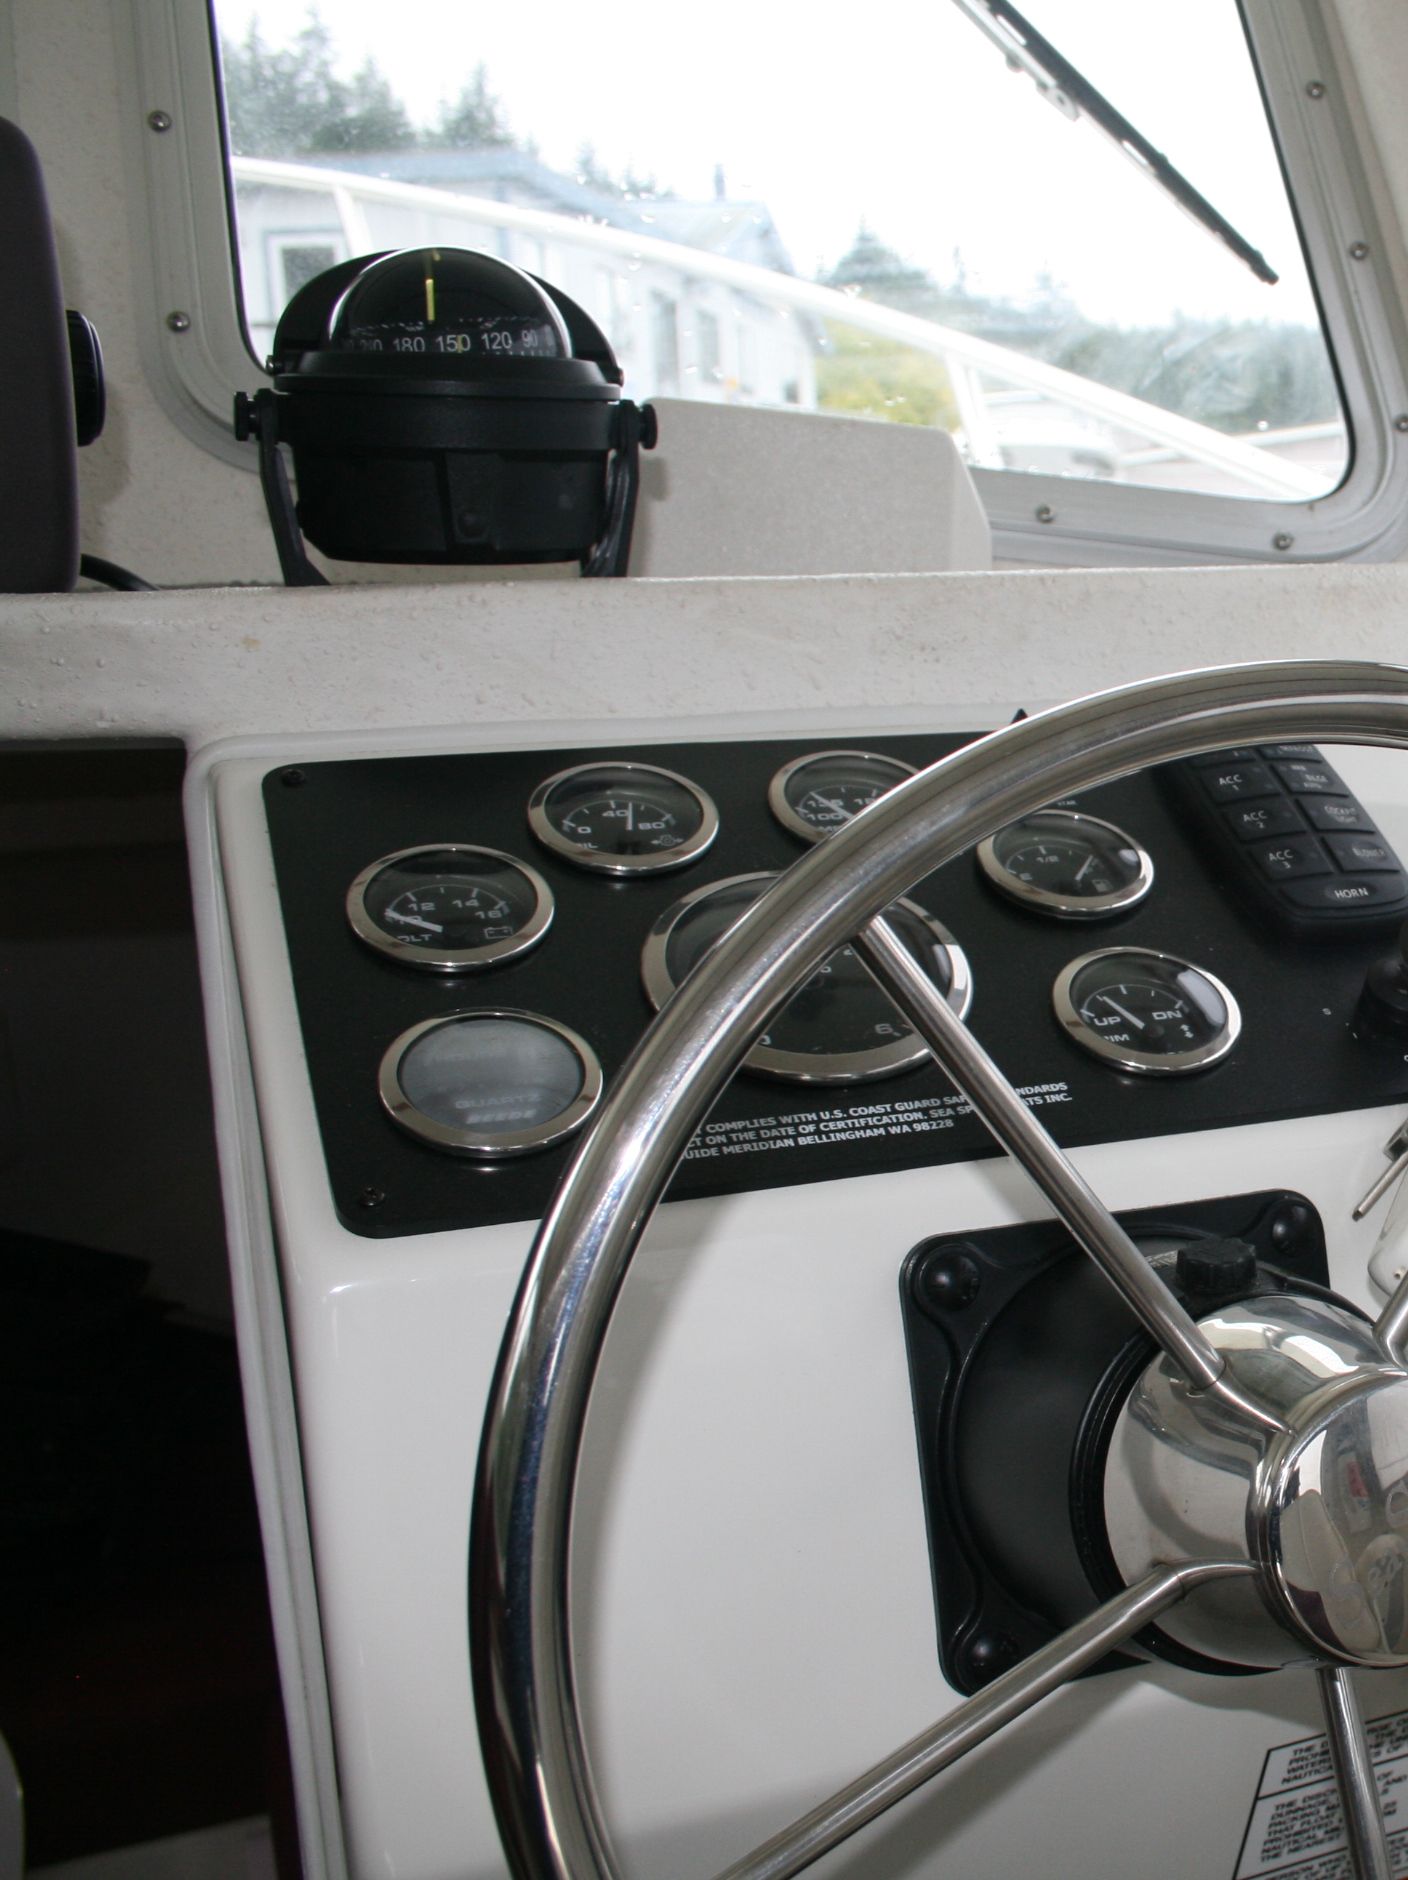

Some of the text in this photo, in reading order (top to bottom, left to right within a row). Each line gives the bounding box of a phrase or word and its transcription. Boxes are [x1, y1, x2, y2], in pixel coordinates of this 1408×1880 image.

[392, 337, 425, 351] 180
[435, 335, 471, 351] 150
[481, 332, 512, 349] 120
[521, 330, 539, 348] 90
[1218, 773, 1243, 786] ACC
[602, 809, 629, 818] 40
[807, 812, 843, 821] 100
[1243, 810, 1268, 823] ACC
[577, 826, 592, 834] 0
[638, 821, 666, 831] 80
[1256, 821, 1266, 829] 2
[575, 842, 598, 850] IL
[1268, 849, 1293, 862] ACC
[1281, 861, 1292, 870] 3
[1334, 887, 1369, 899] HORN
[407, 901, 437, 912] 12
[451, 899, 481, 909] 14
[474, 909, 503, 920] 16
[1093, 1015, 1122, 1027] UP
[1152, 1009, 1183, 1021] DN
[455, 1091, 541, 1109] QUARTZ
[706, 1116, 777, 1134] COMPLIES
[777, 1112, 819, 1125] WITH
[819, 1109, 848, 1120] U.S.
[848, 1104, 893, 1117] COAST
[894, 1098, 941, 1112] GUARD
[1014, 1082, 1068, 1097] NDARDS
[705, 1134, 728, 1146] ON
[729, 1130, 758, 1143] THE
[759, 1126, 797, 1140] DATE
[798, 1123, 818, 1135] OF
[820, 1110, 928, 1132] CERTIFICATION.
[929, 1106, 956, 1119] SEA
[1045, 1093, 1073, 1104] INC.
[721, 1138, 796, 1156] MERIDIAN
[798, 1127, 886, 1147] BELLINGHAM
[887, 1124, 913, 1136] WA
[914, 1118, 955, 1133] 98228
[1281, 1765, 1334, 1785] NAUTICA
